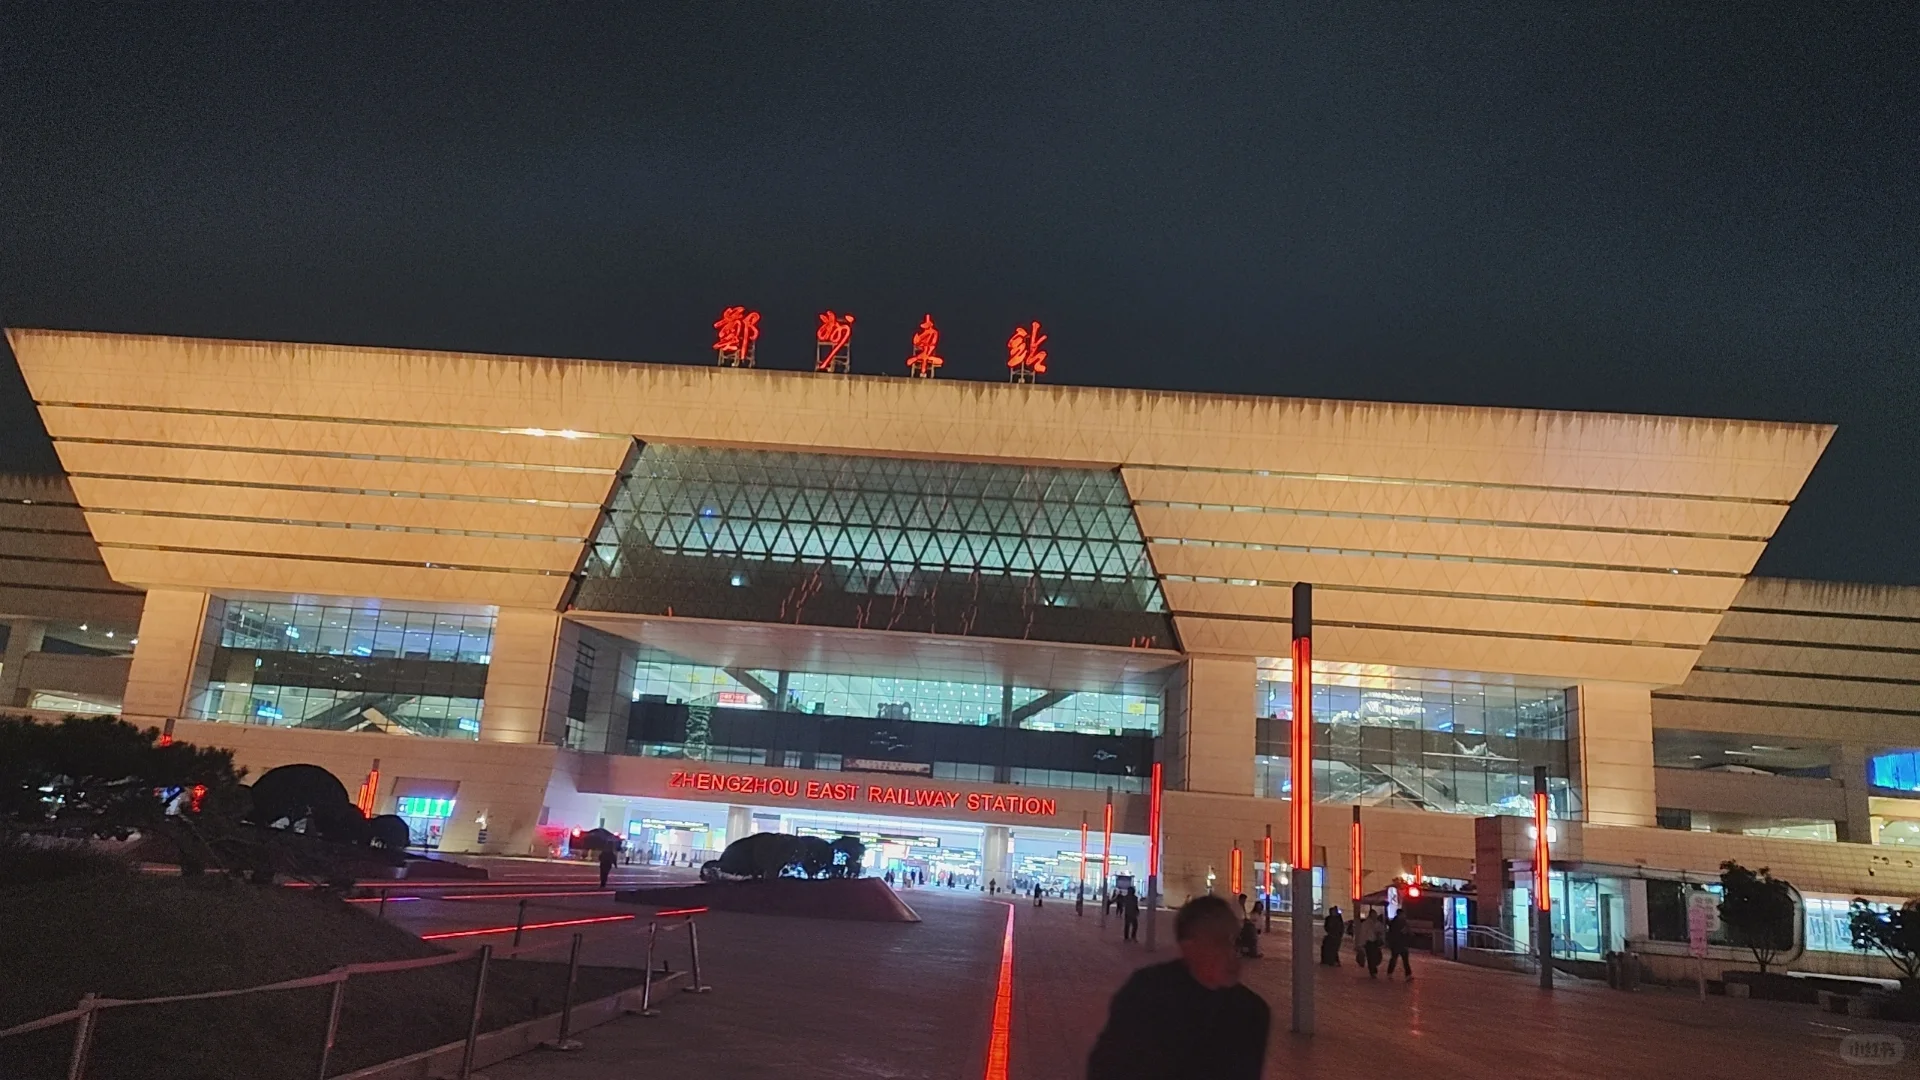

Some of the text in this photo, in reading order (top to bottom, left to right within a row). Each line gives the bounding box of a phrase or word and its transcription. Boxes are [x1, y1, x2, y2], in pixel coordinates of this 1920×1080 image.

[669, 771, 1057, 815] ZHENGZHOU EAST RAILWAY STATION
